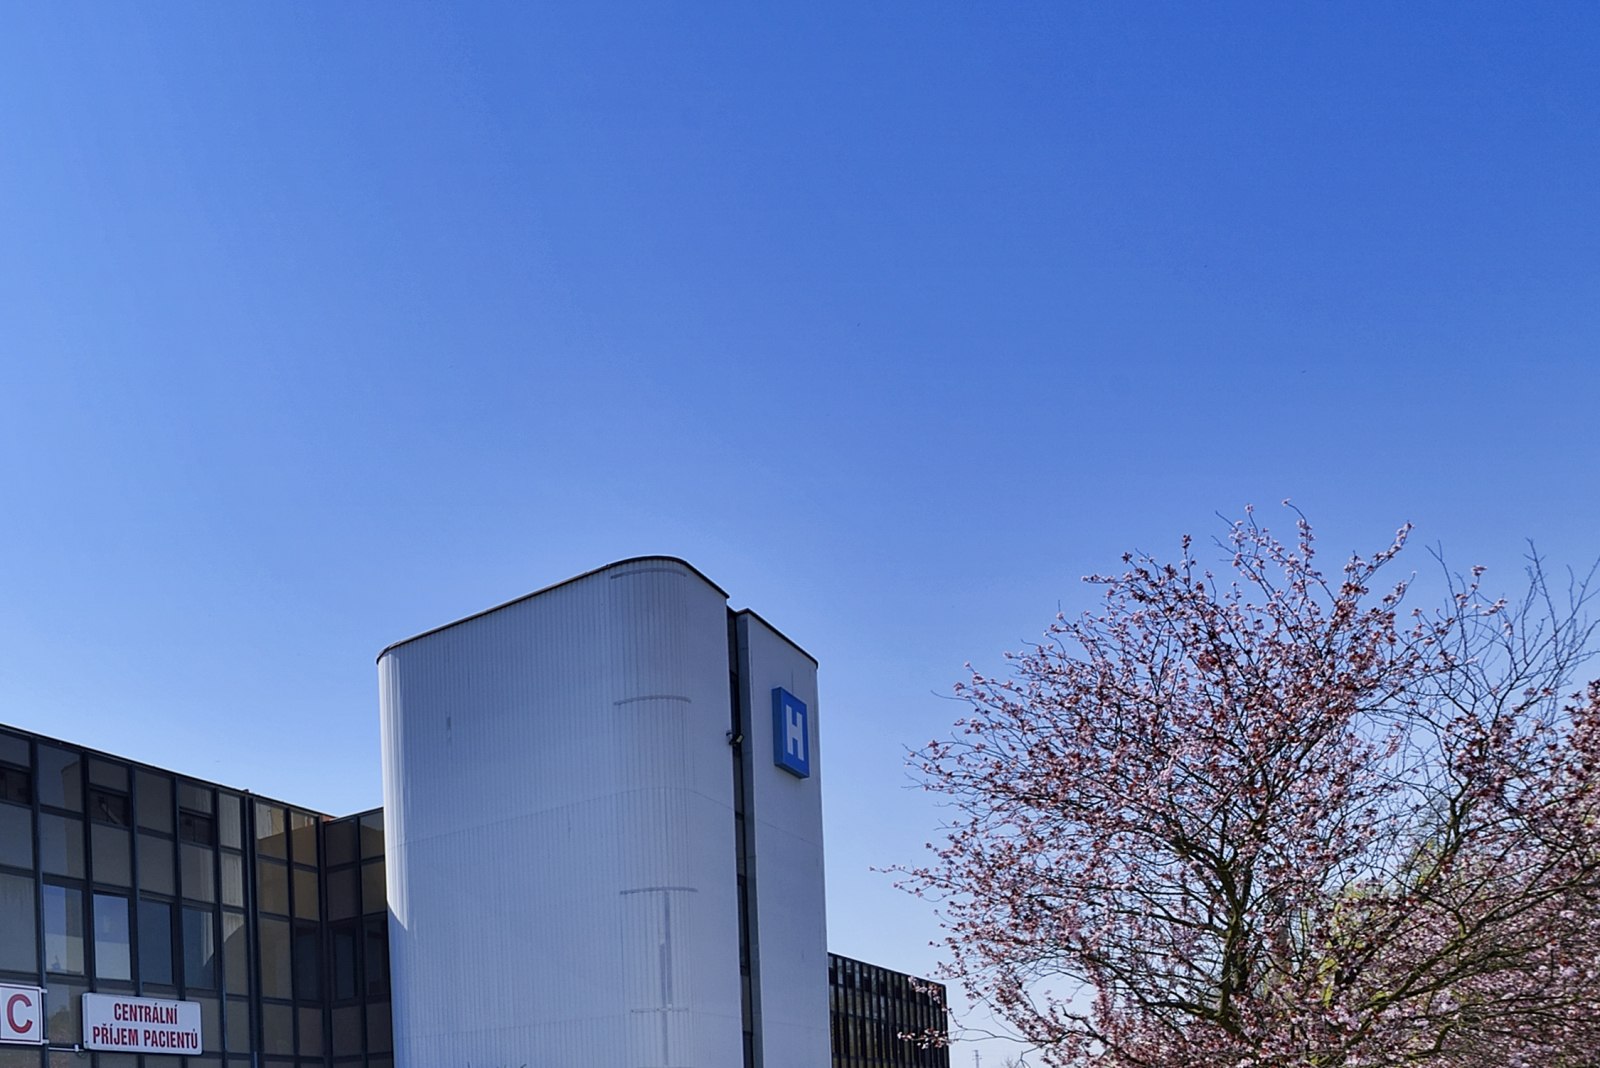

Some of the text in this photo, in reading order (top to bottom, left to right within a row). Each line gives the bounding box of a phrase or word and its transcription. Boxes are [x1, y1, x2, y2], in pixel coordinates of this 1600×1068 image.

[785, 704, 805, 762] H
[6, 993, 33, 1034] C
[113, 1002, 178, 1025] CENTRÁLNÍ
[92, 1023, 199, 1050] PŘÍJEM PACIENTŮ
